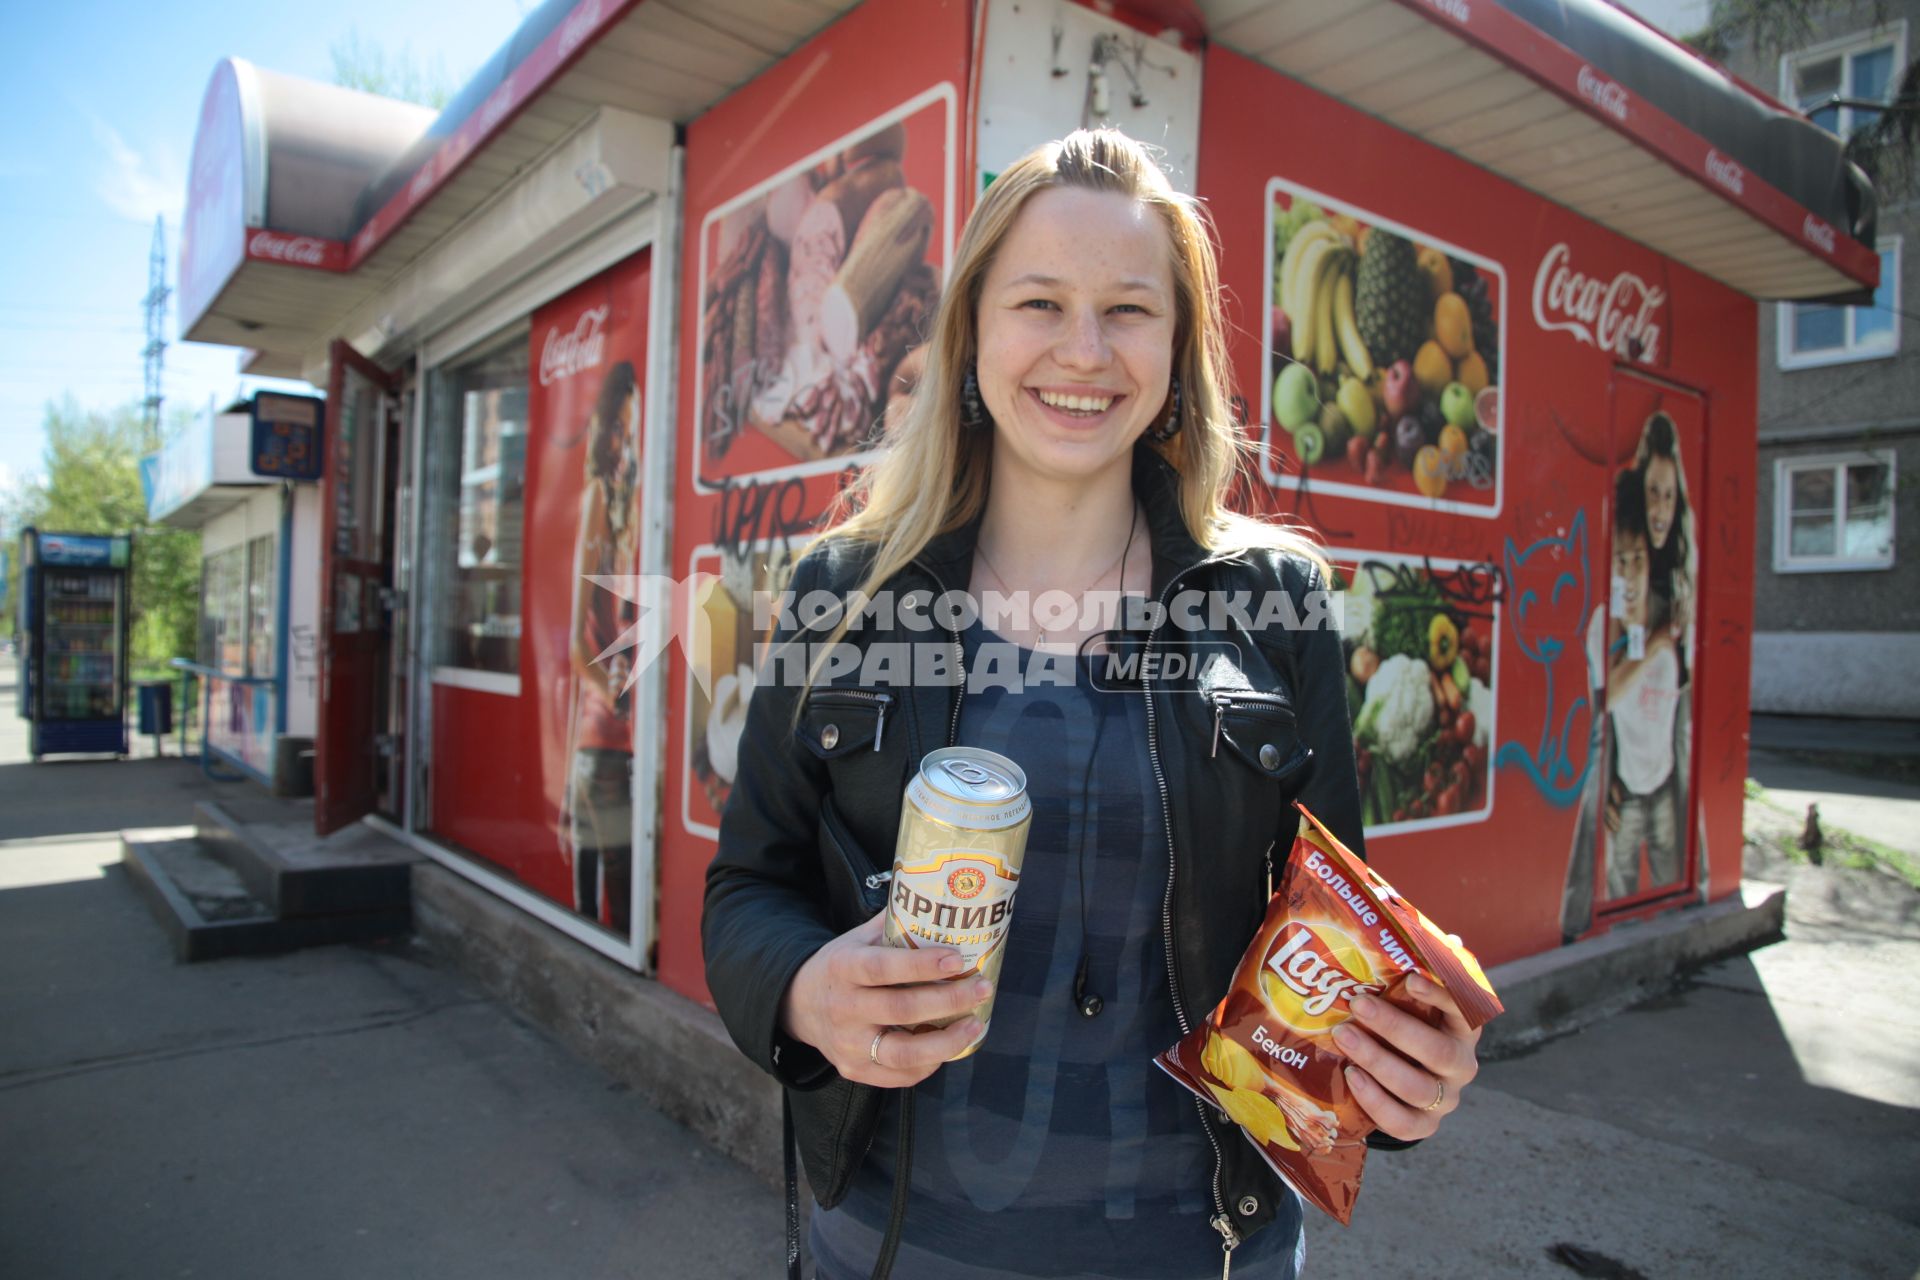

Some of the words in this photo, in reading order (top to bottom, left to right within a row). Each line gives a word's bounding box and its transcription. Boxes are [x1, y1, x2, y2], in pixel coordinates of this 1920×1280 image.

[909, 922, 1001, 946] ЯНТАРНОЕ
[1304, 850, 1378, 927] Больше
[1379, 928, 1421, 972] чип
[1251, 1024, 1309, 1070] Бекон
